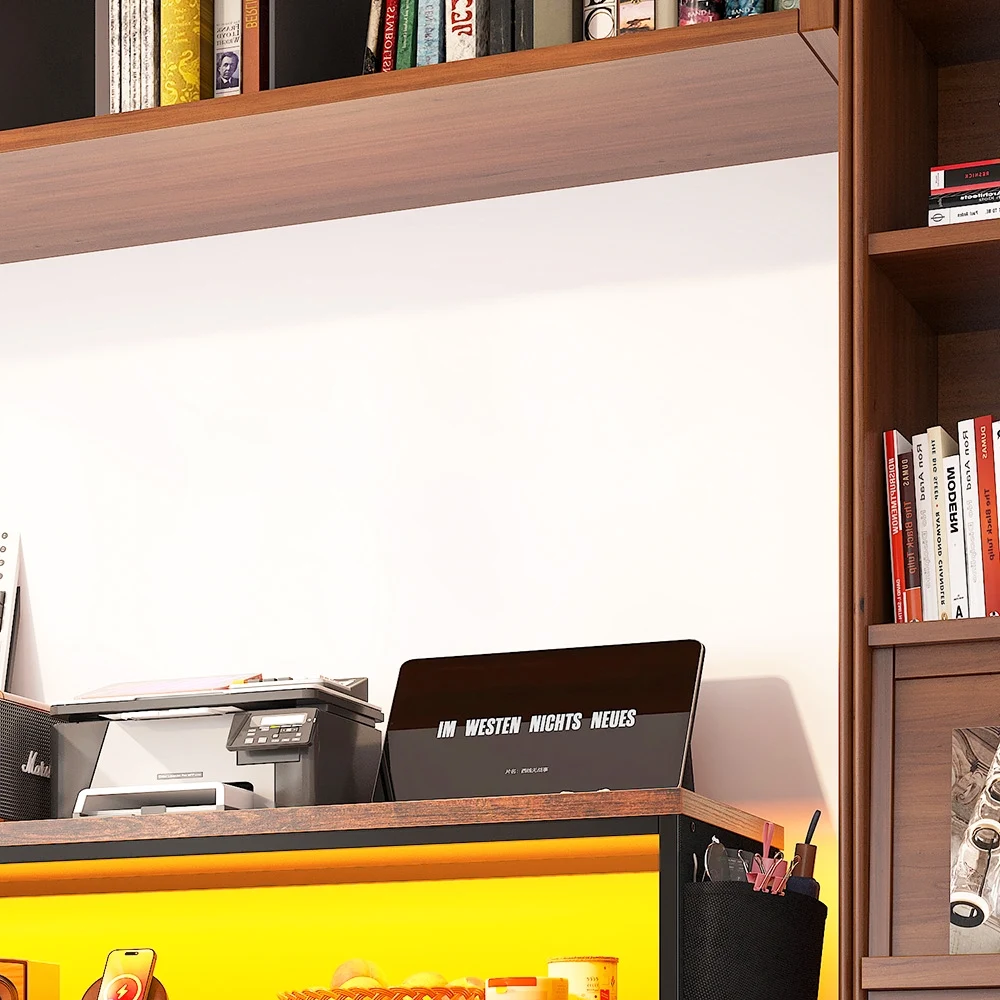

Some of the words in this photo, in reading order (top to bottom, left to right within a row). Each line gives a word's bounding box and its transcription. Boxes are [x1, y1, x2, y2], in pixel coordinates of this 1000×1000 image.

[436, 720, 457, 738] IM
[465, 716, 522, 736] WESTEN
[529, 712, 582, 733] NICHTS
[590, 709, 636, 729] NEUES
